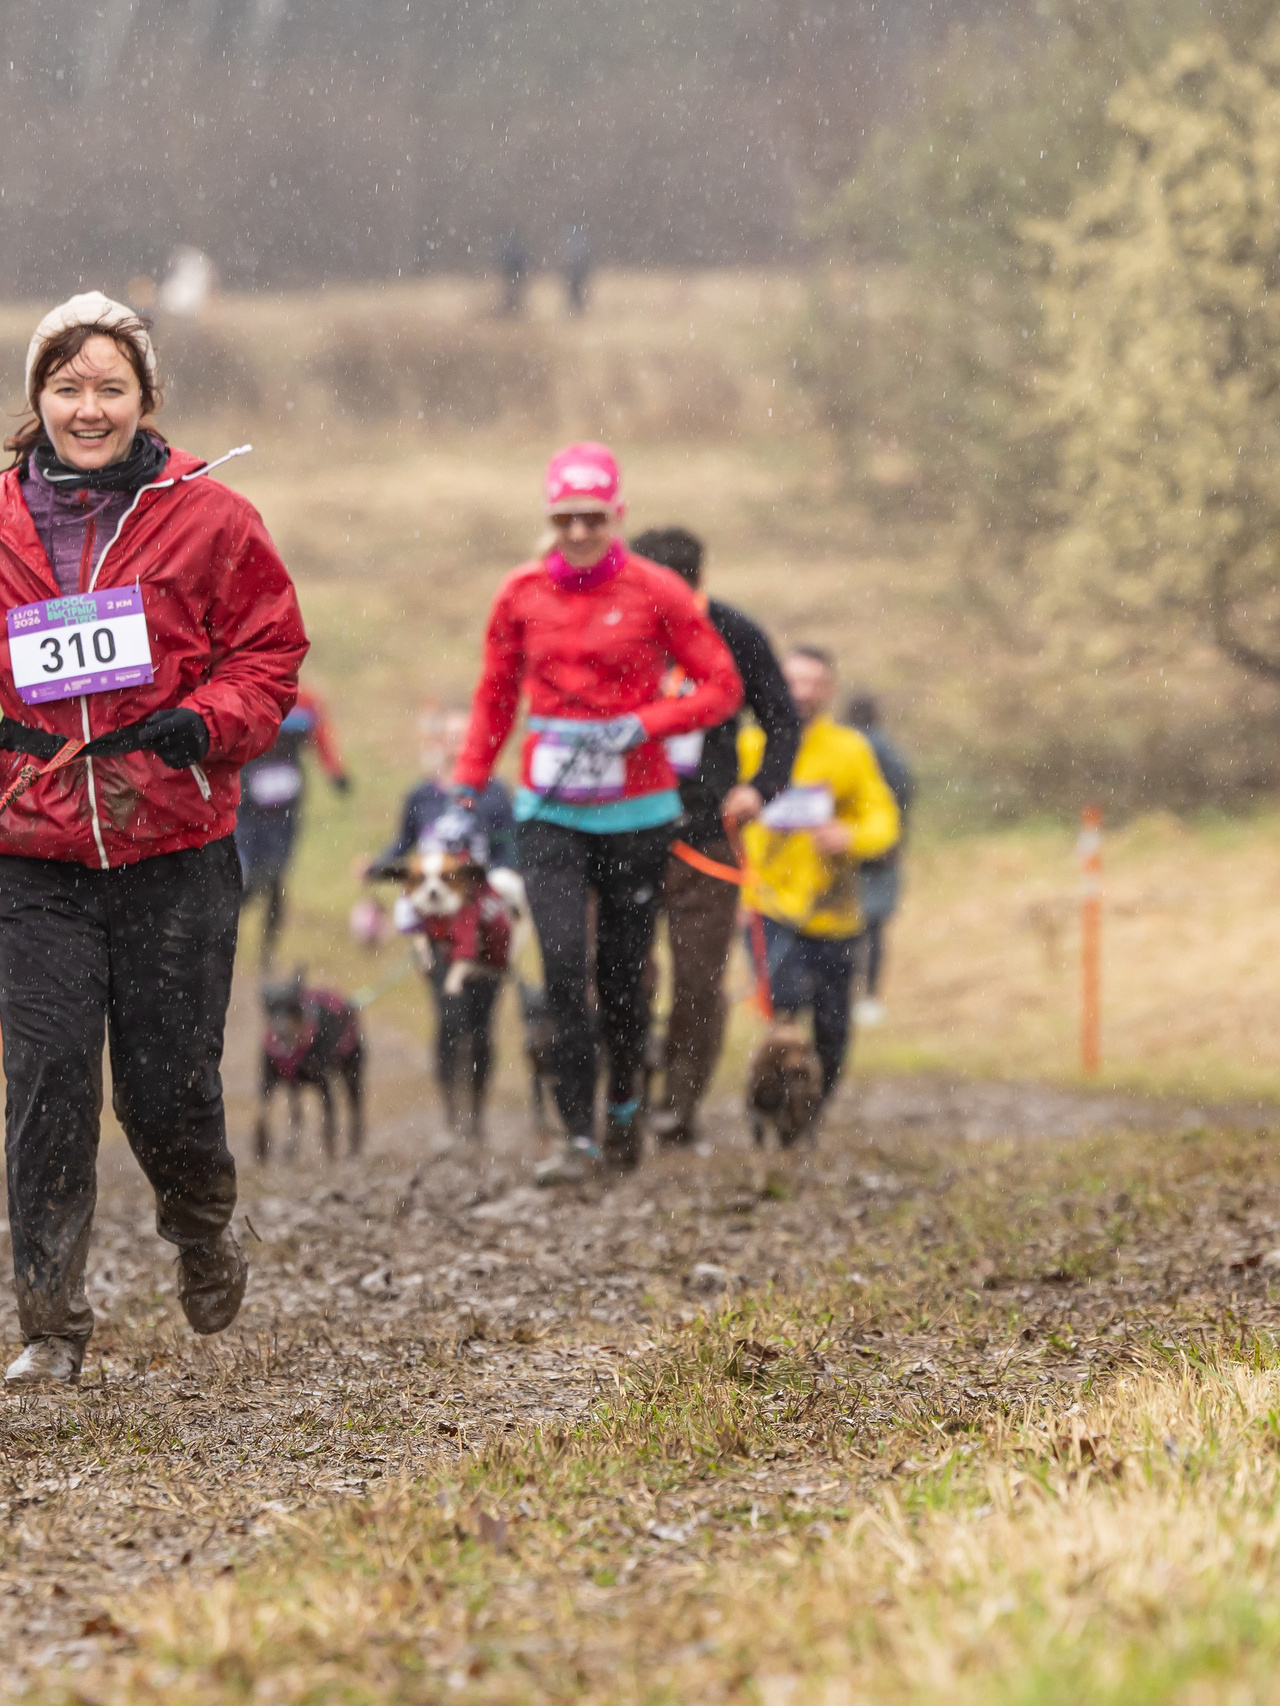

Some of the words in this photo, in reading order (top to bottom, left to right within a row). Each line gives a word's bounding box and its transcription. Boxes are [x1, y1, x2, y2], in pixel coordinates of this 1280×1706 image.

[107, 601, 114, 610] 2
[14, 617, 41, 629] 2026
[40, 628, 116, 673] 310
